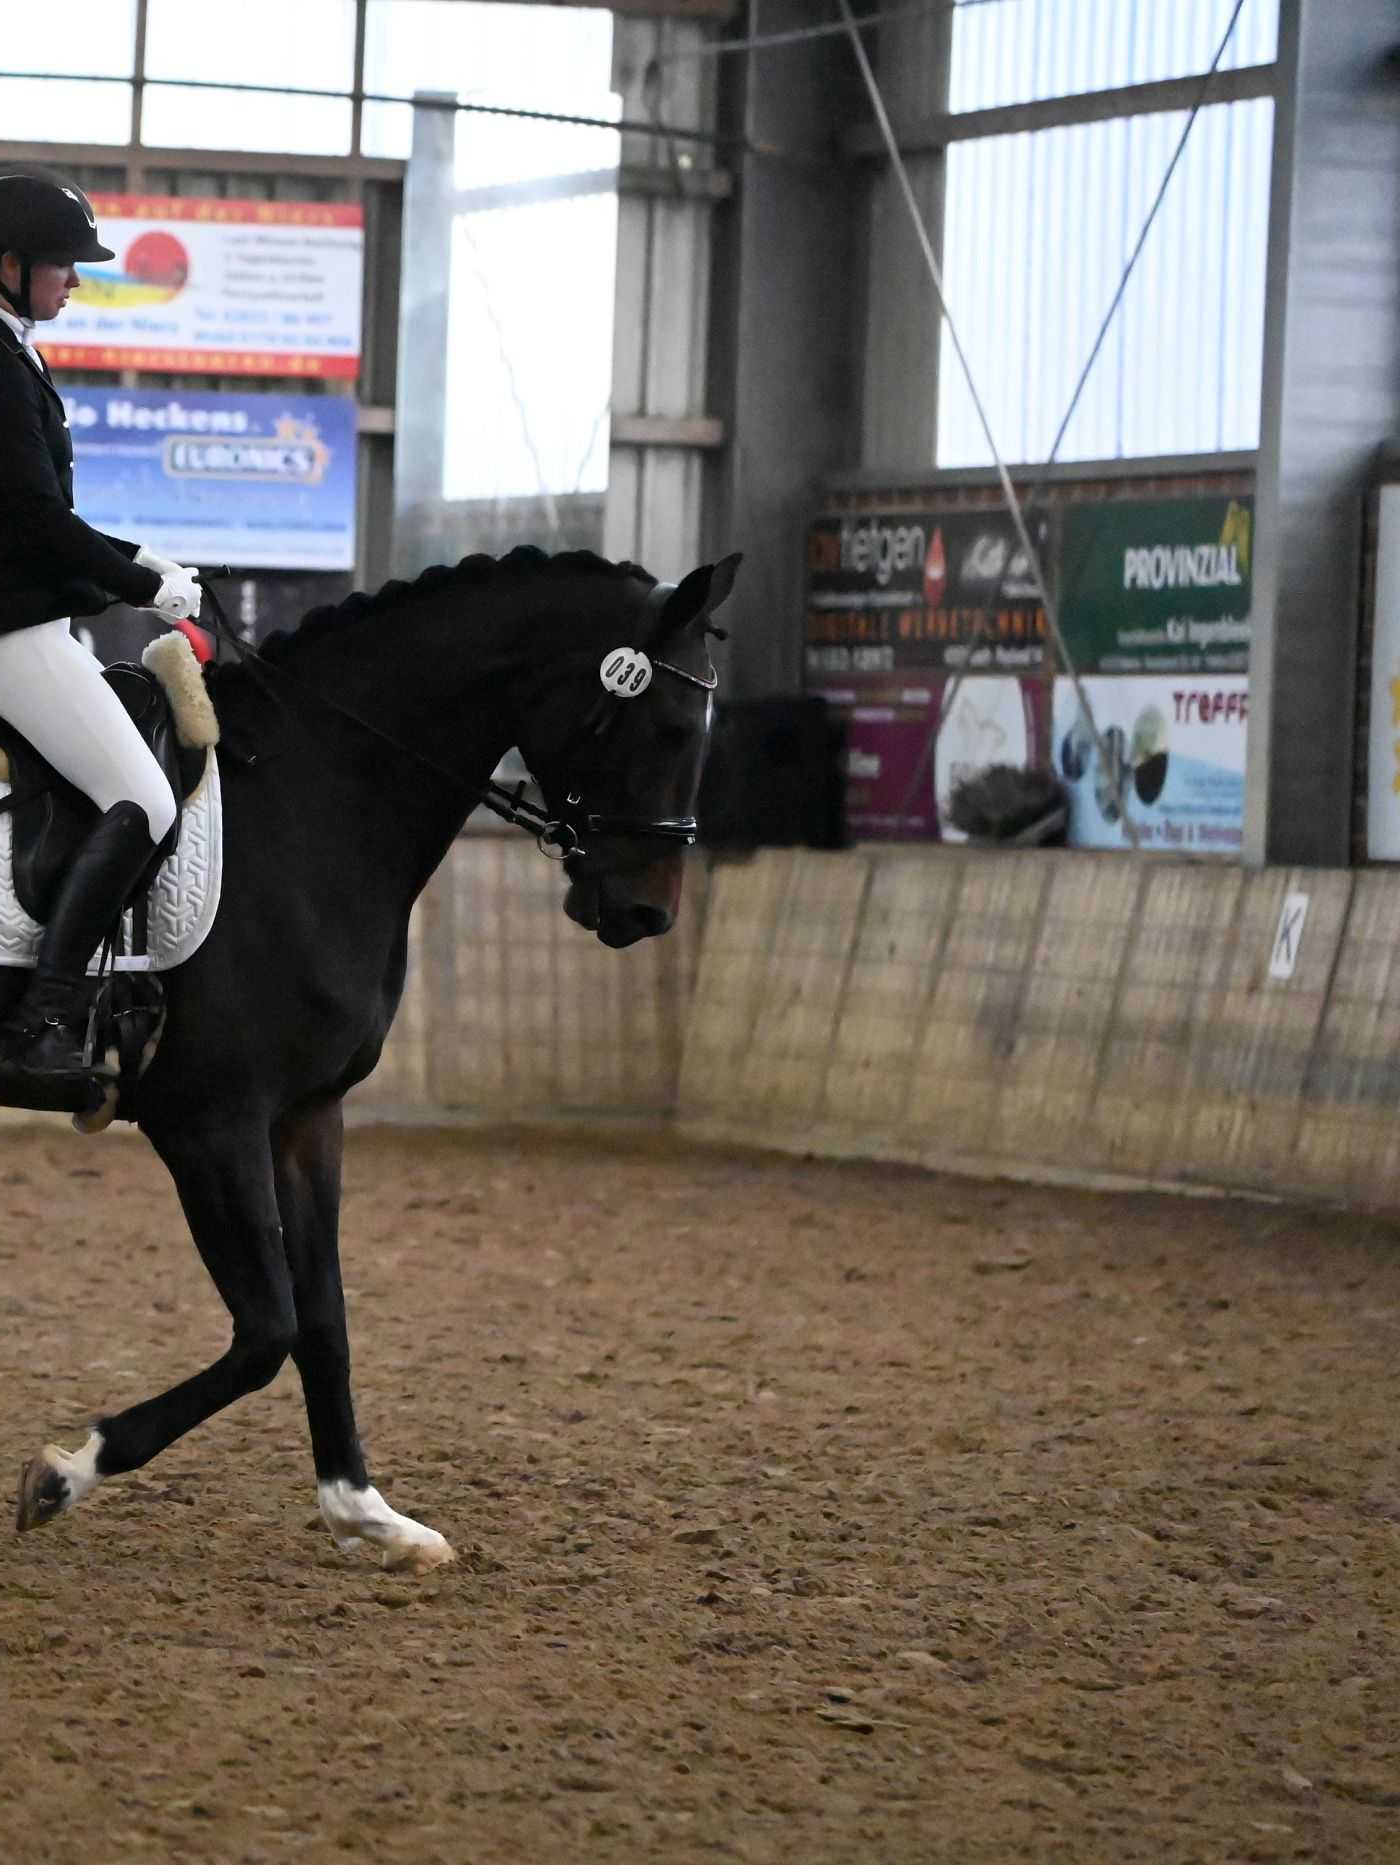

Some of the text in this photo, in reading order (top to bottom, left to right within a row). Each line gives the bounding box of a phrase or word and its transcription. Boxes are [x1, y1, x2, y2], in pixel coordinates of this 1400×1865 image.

[174, 442, 315, 472] EURONICS
[1123, 544, 1243, 590] PROVINZIAL
[604, 655, 647, 692] 039
[1275, 906, 1302, 965] K
